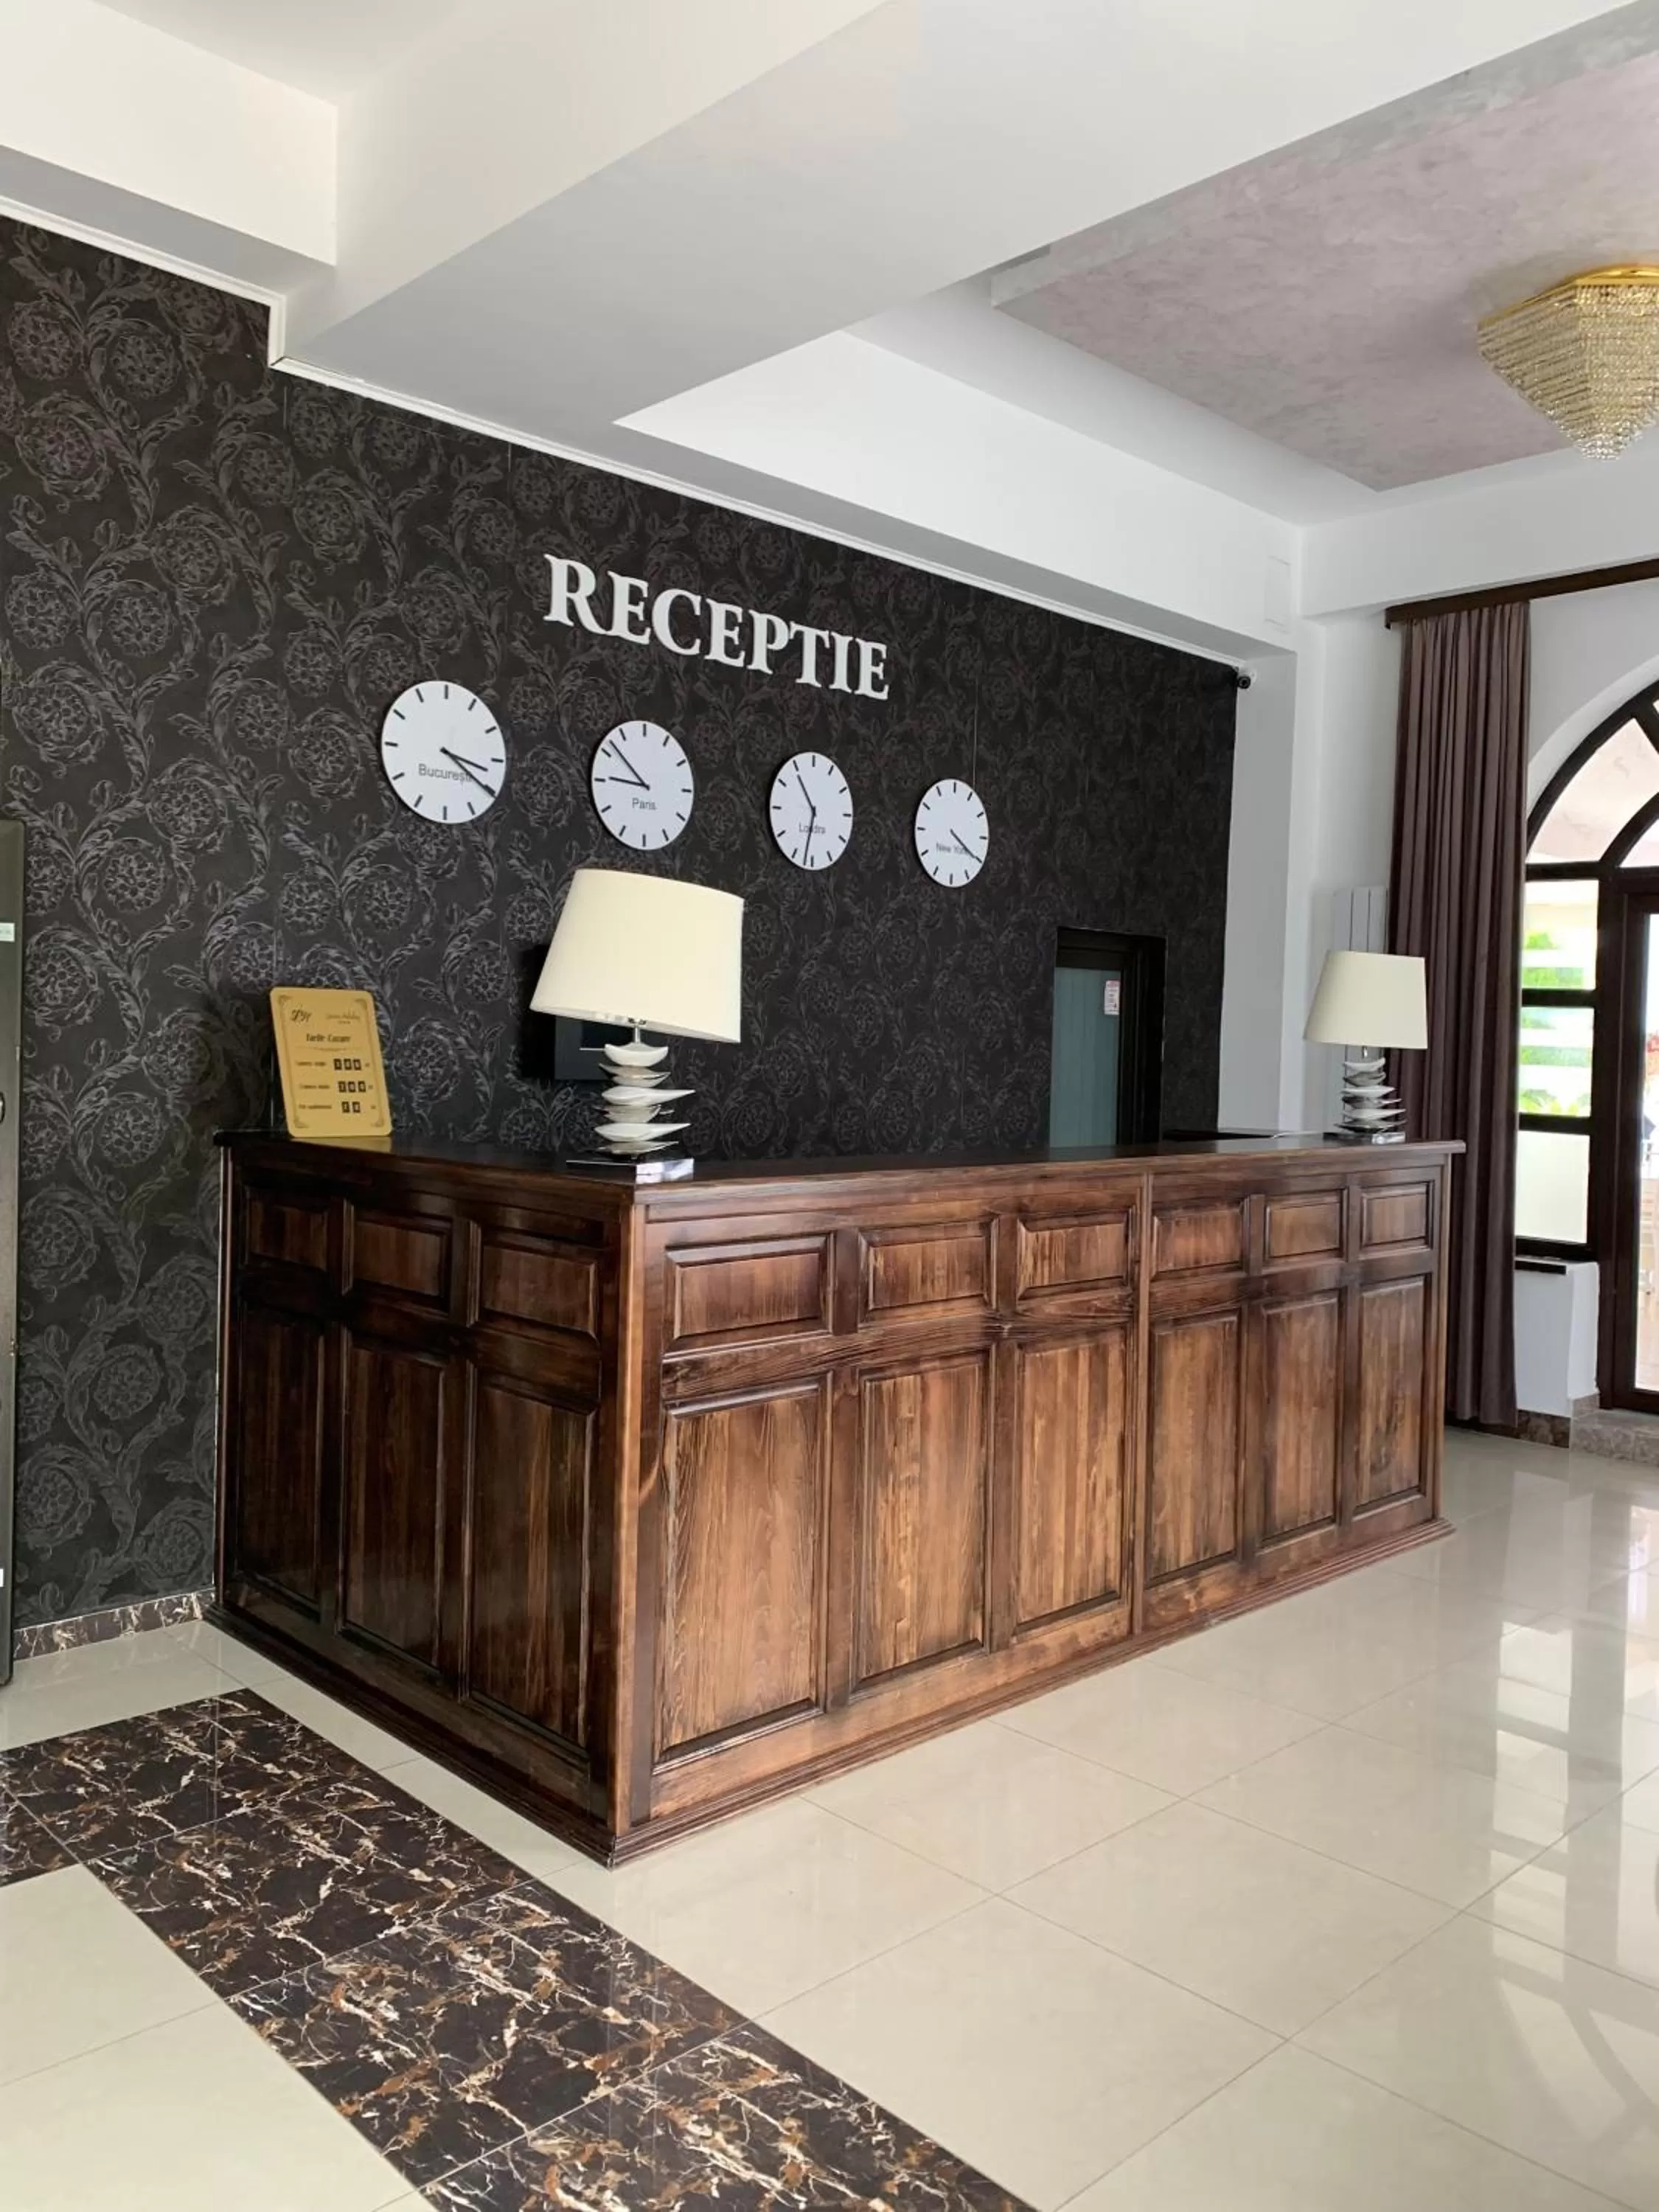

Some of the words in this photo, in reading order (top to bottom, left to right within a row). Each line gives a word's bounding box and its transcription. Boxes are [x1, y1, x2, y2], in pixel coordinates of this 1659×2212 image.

[543, 554, 889, 700] RECEPTIE
[632, 798, 657, 810] Paris
[799, 822, 827, 835] Lodra
